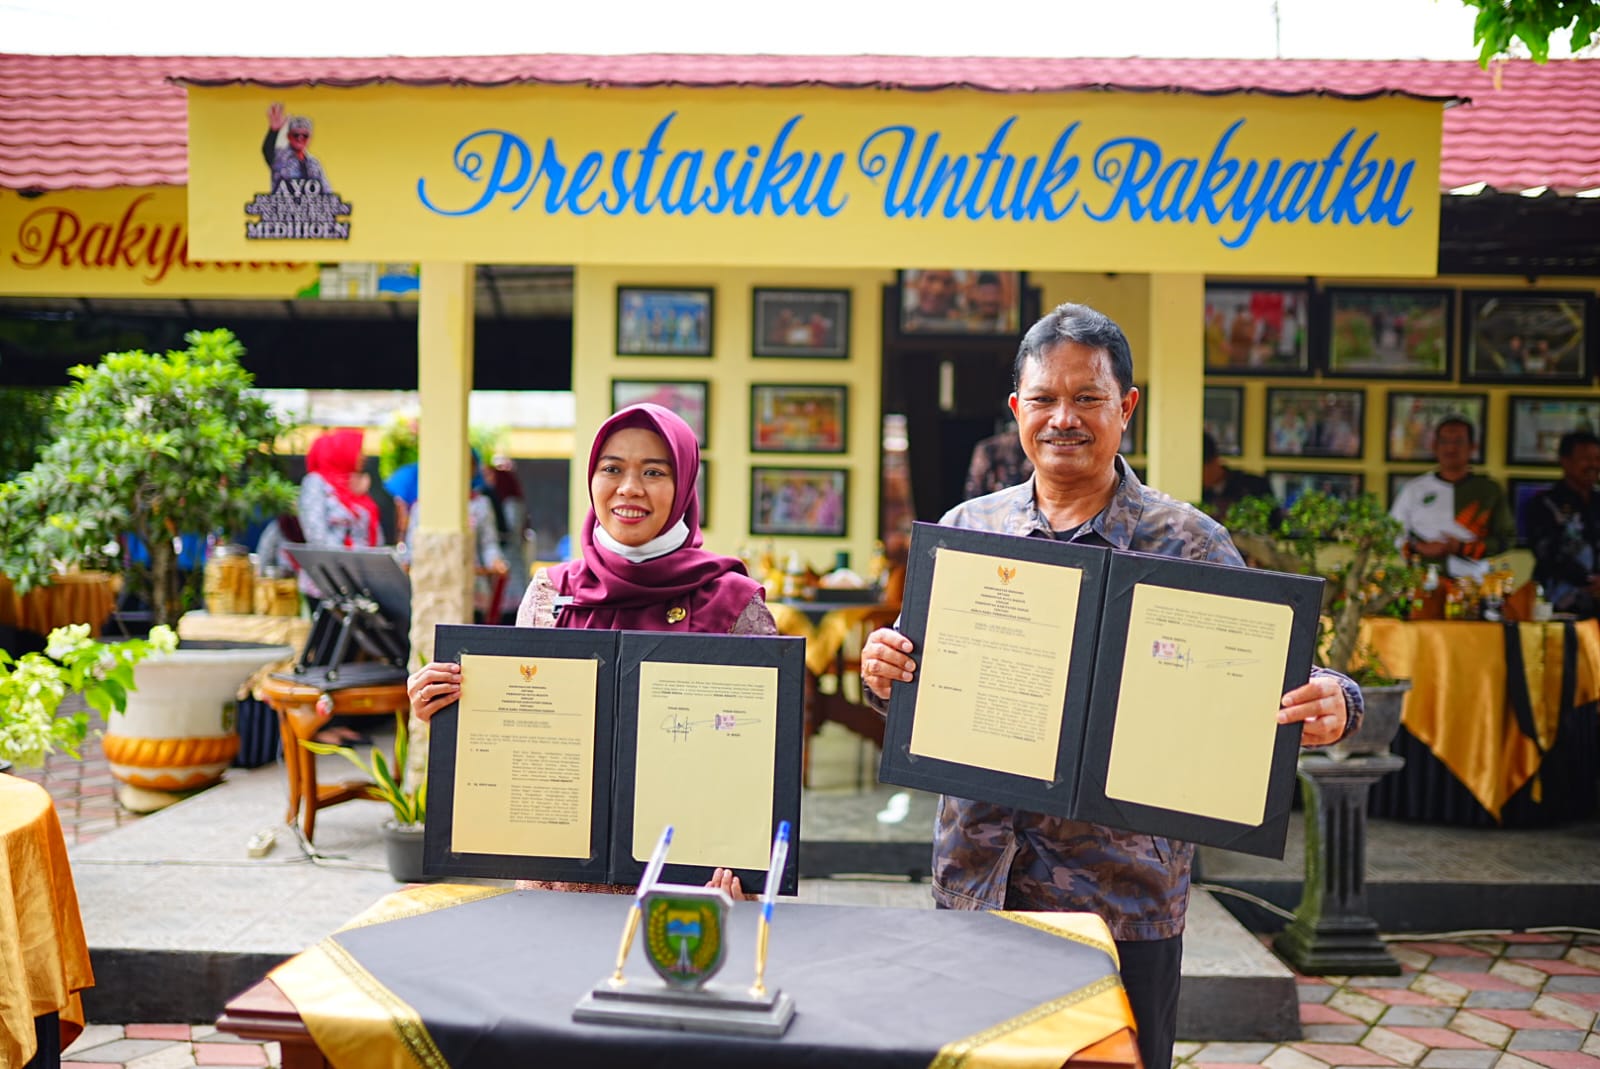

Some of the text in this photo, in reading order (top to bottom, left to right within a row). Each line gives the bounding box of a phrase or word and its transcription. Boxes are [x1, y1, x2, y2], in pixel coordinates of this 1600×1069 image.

[276, 178, 322, 198] AYO
[418, 112, 1416, 250] Prestasiku Untuk Rakyatku
